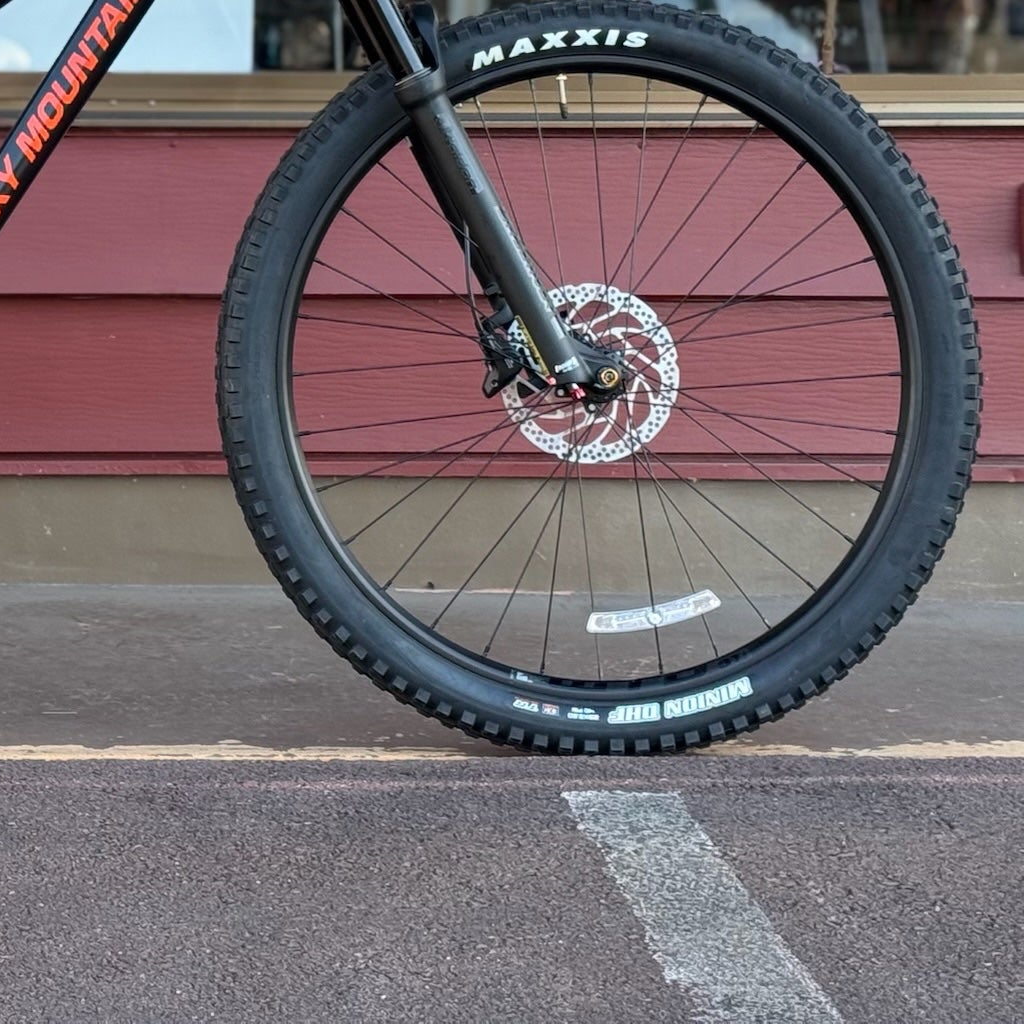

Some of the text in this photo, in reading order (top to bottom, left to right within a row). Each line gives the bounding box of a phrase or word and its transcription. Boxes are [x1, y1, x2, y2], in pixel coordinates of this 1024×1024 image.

[472, 29, 649, 71] MAXXIS
[607, 702, 661, 724] DHF
[663, 676, 754, 719] MINION
